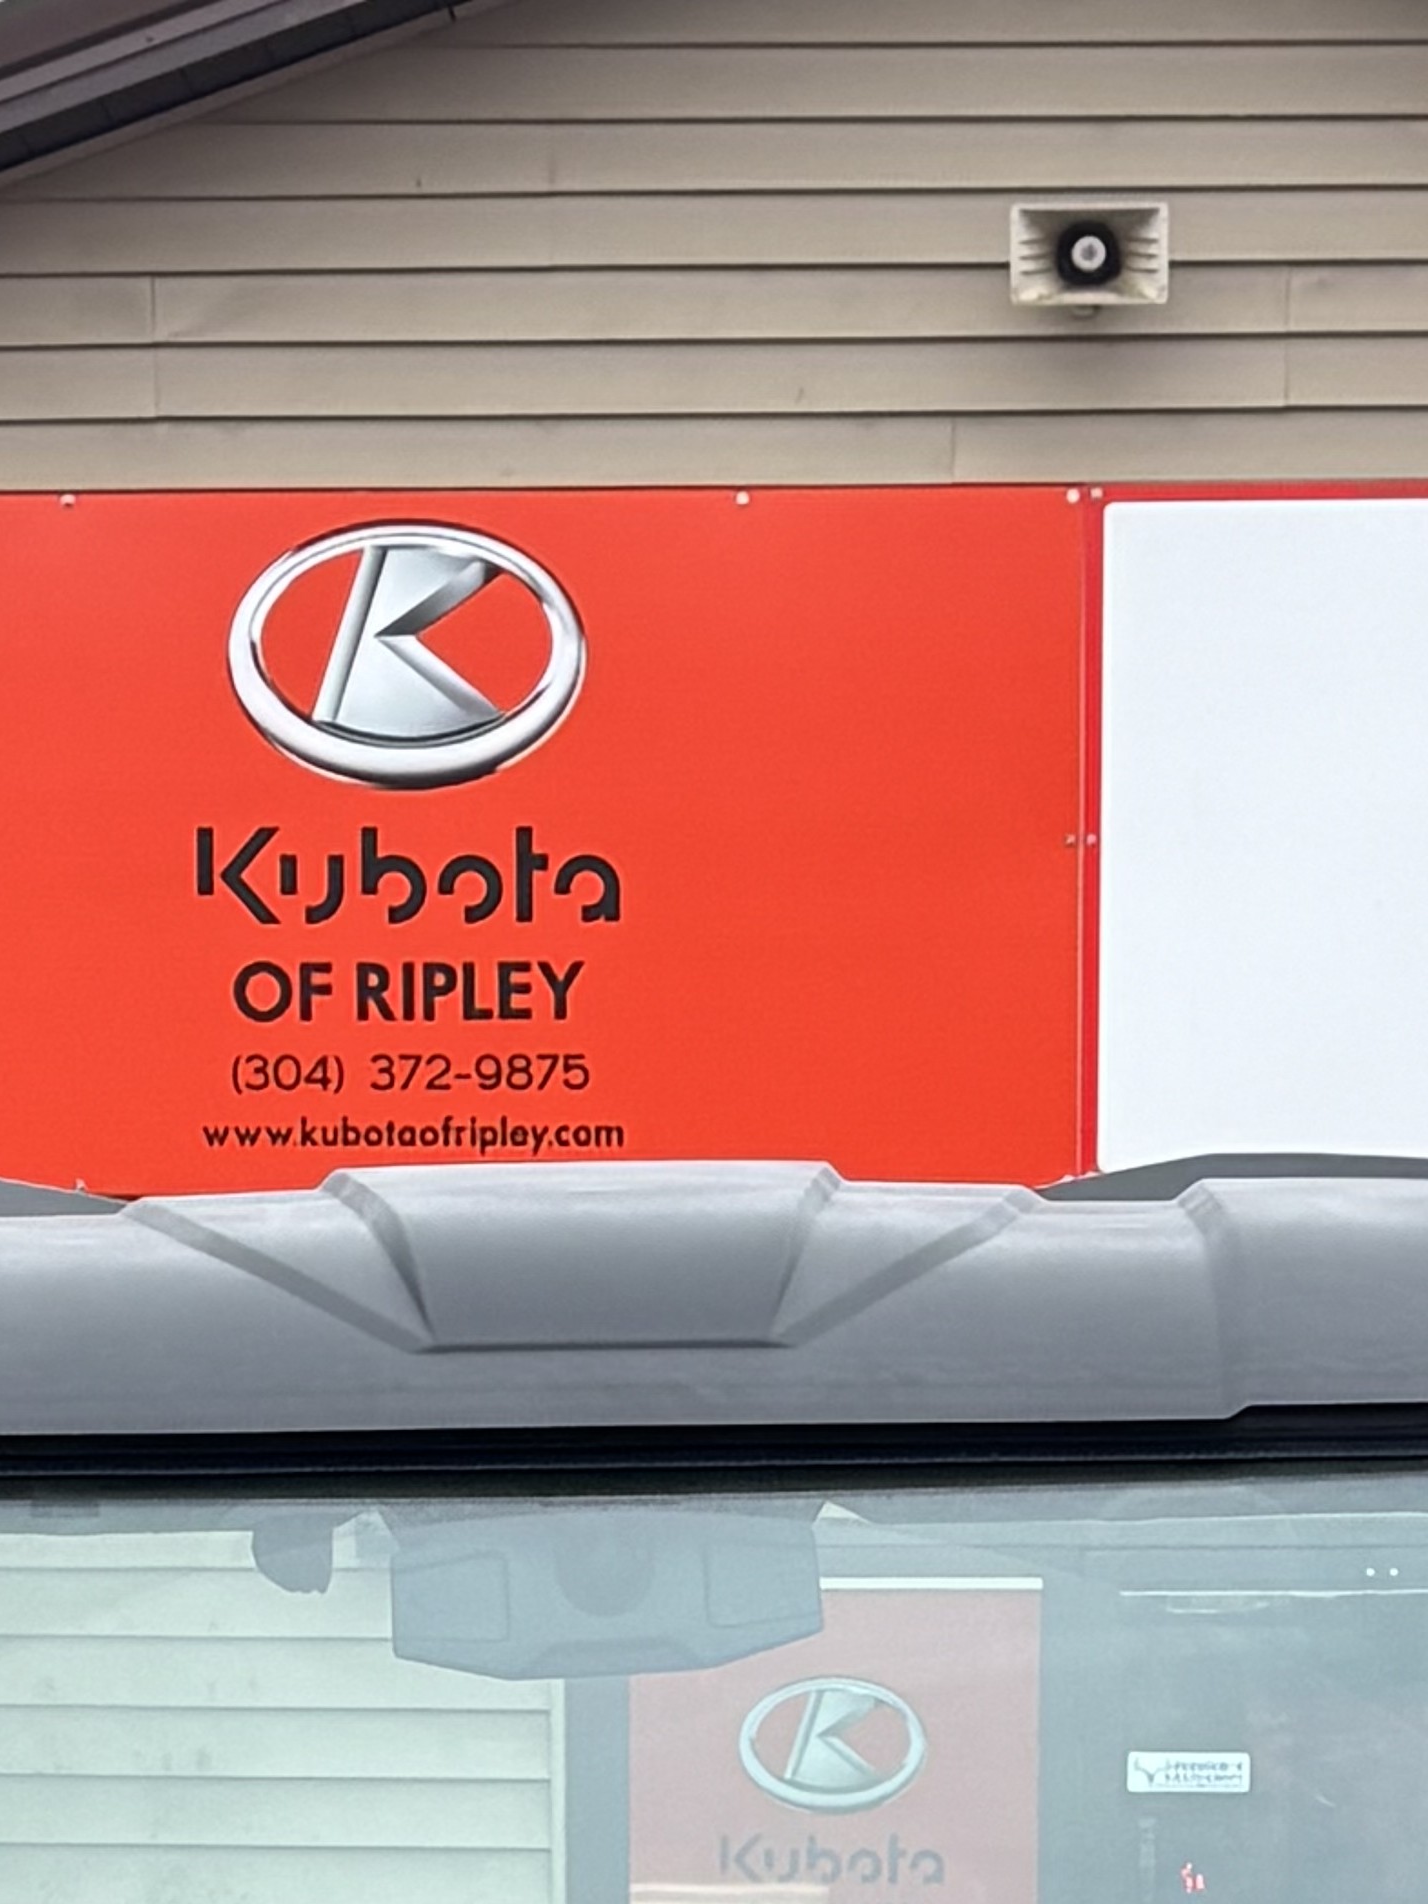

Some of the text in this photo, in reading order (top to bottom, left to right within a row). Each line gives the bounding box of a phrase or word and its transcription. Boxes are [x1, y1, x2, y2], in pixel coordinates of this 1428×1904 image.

[195, 825, 622, 925] Kubota
[233, 959, 585, 1023] OF RIPLEY
[229, 1052, 591, 1096] (304) 372-9875
[203, 1116, 626, 1156] www.kubotaofripley.com
[719, 1832, 945, 1885] Kubota
